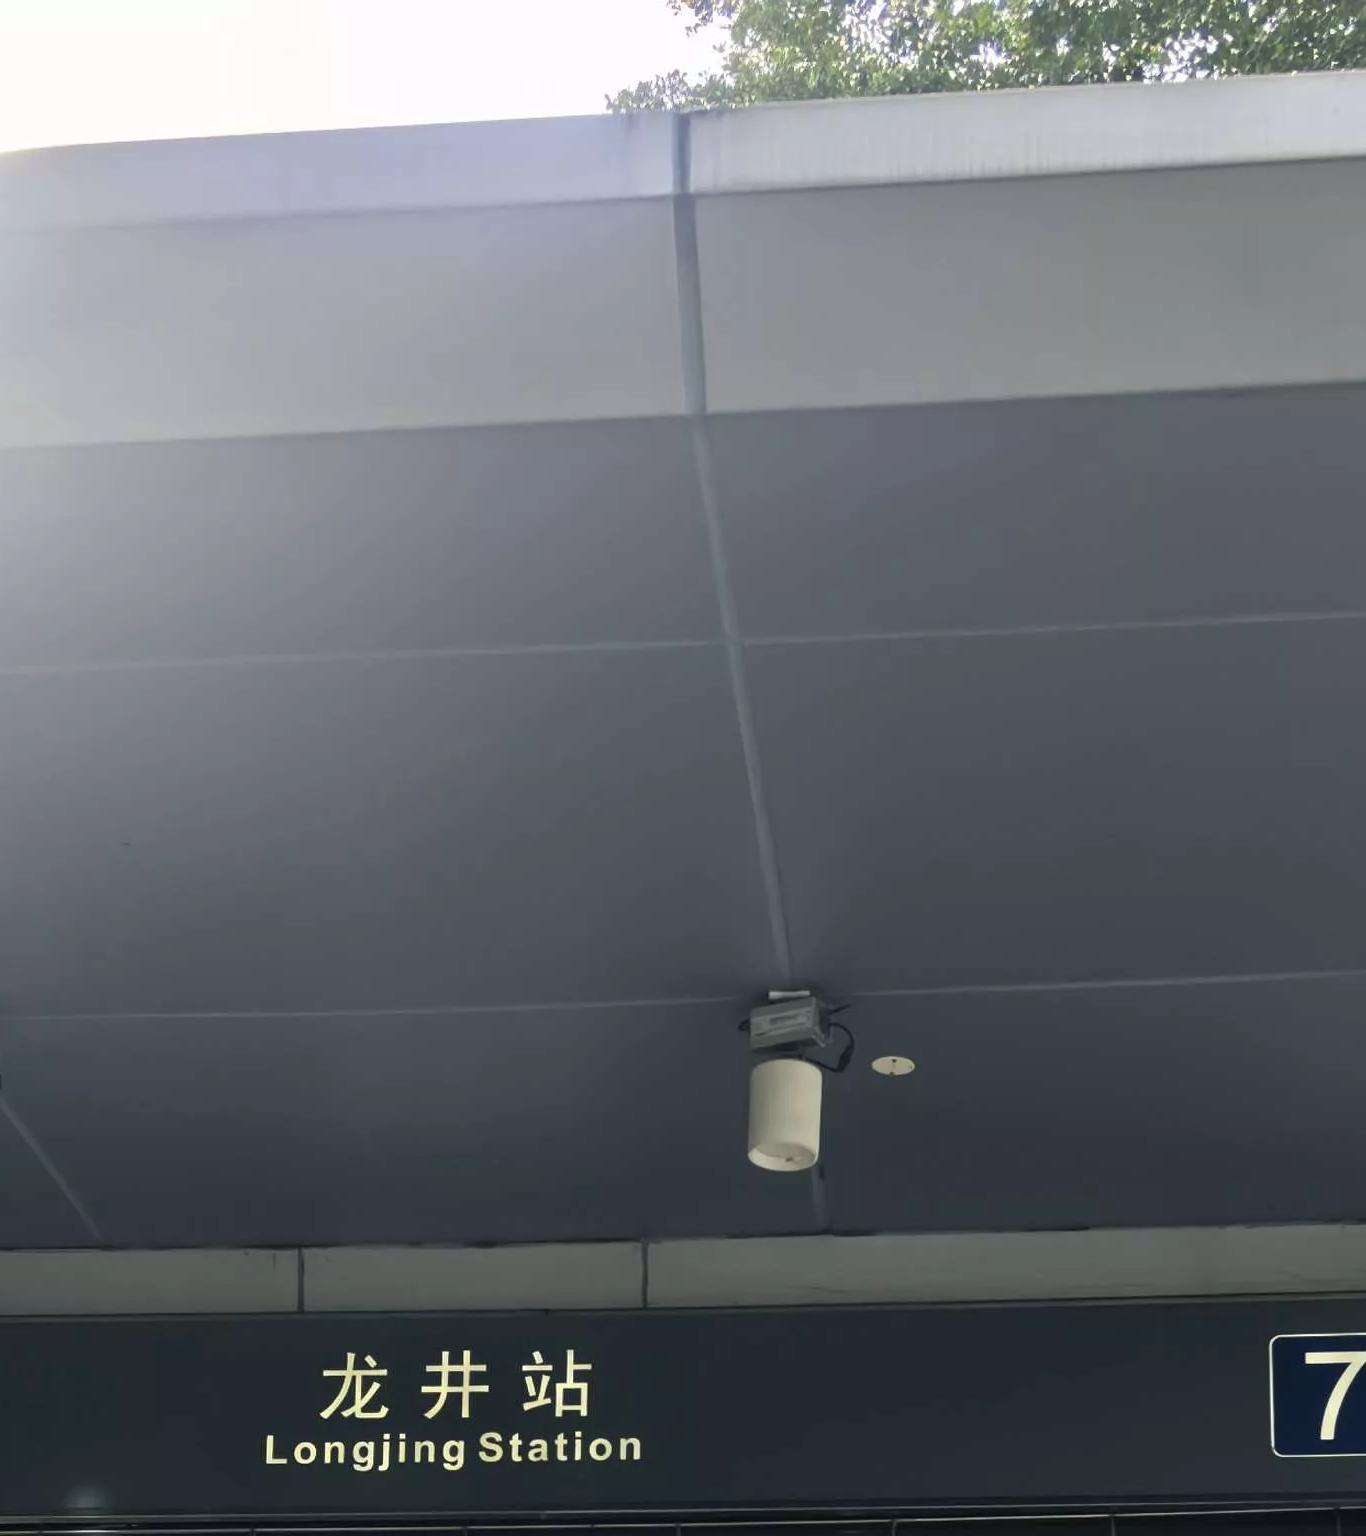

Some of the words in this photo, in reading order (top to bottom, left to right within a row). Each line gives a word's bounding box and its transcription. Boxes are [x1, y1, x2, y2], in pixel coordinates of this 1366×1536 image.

[319, 1349, 592, 1420] 龙井站
[265, 1433, 465, 1472] Longjing
[478, 1431, 641, 1463] Station
